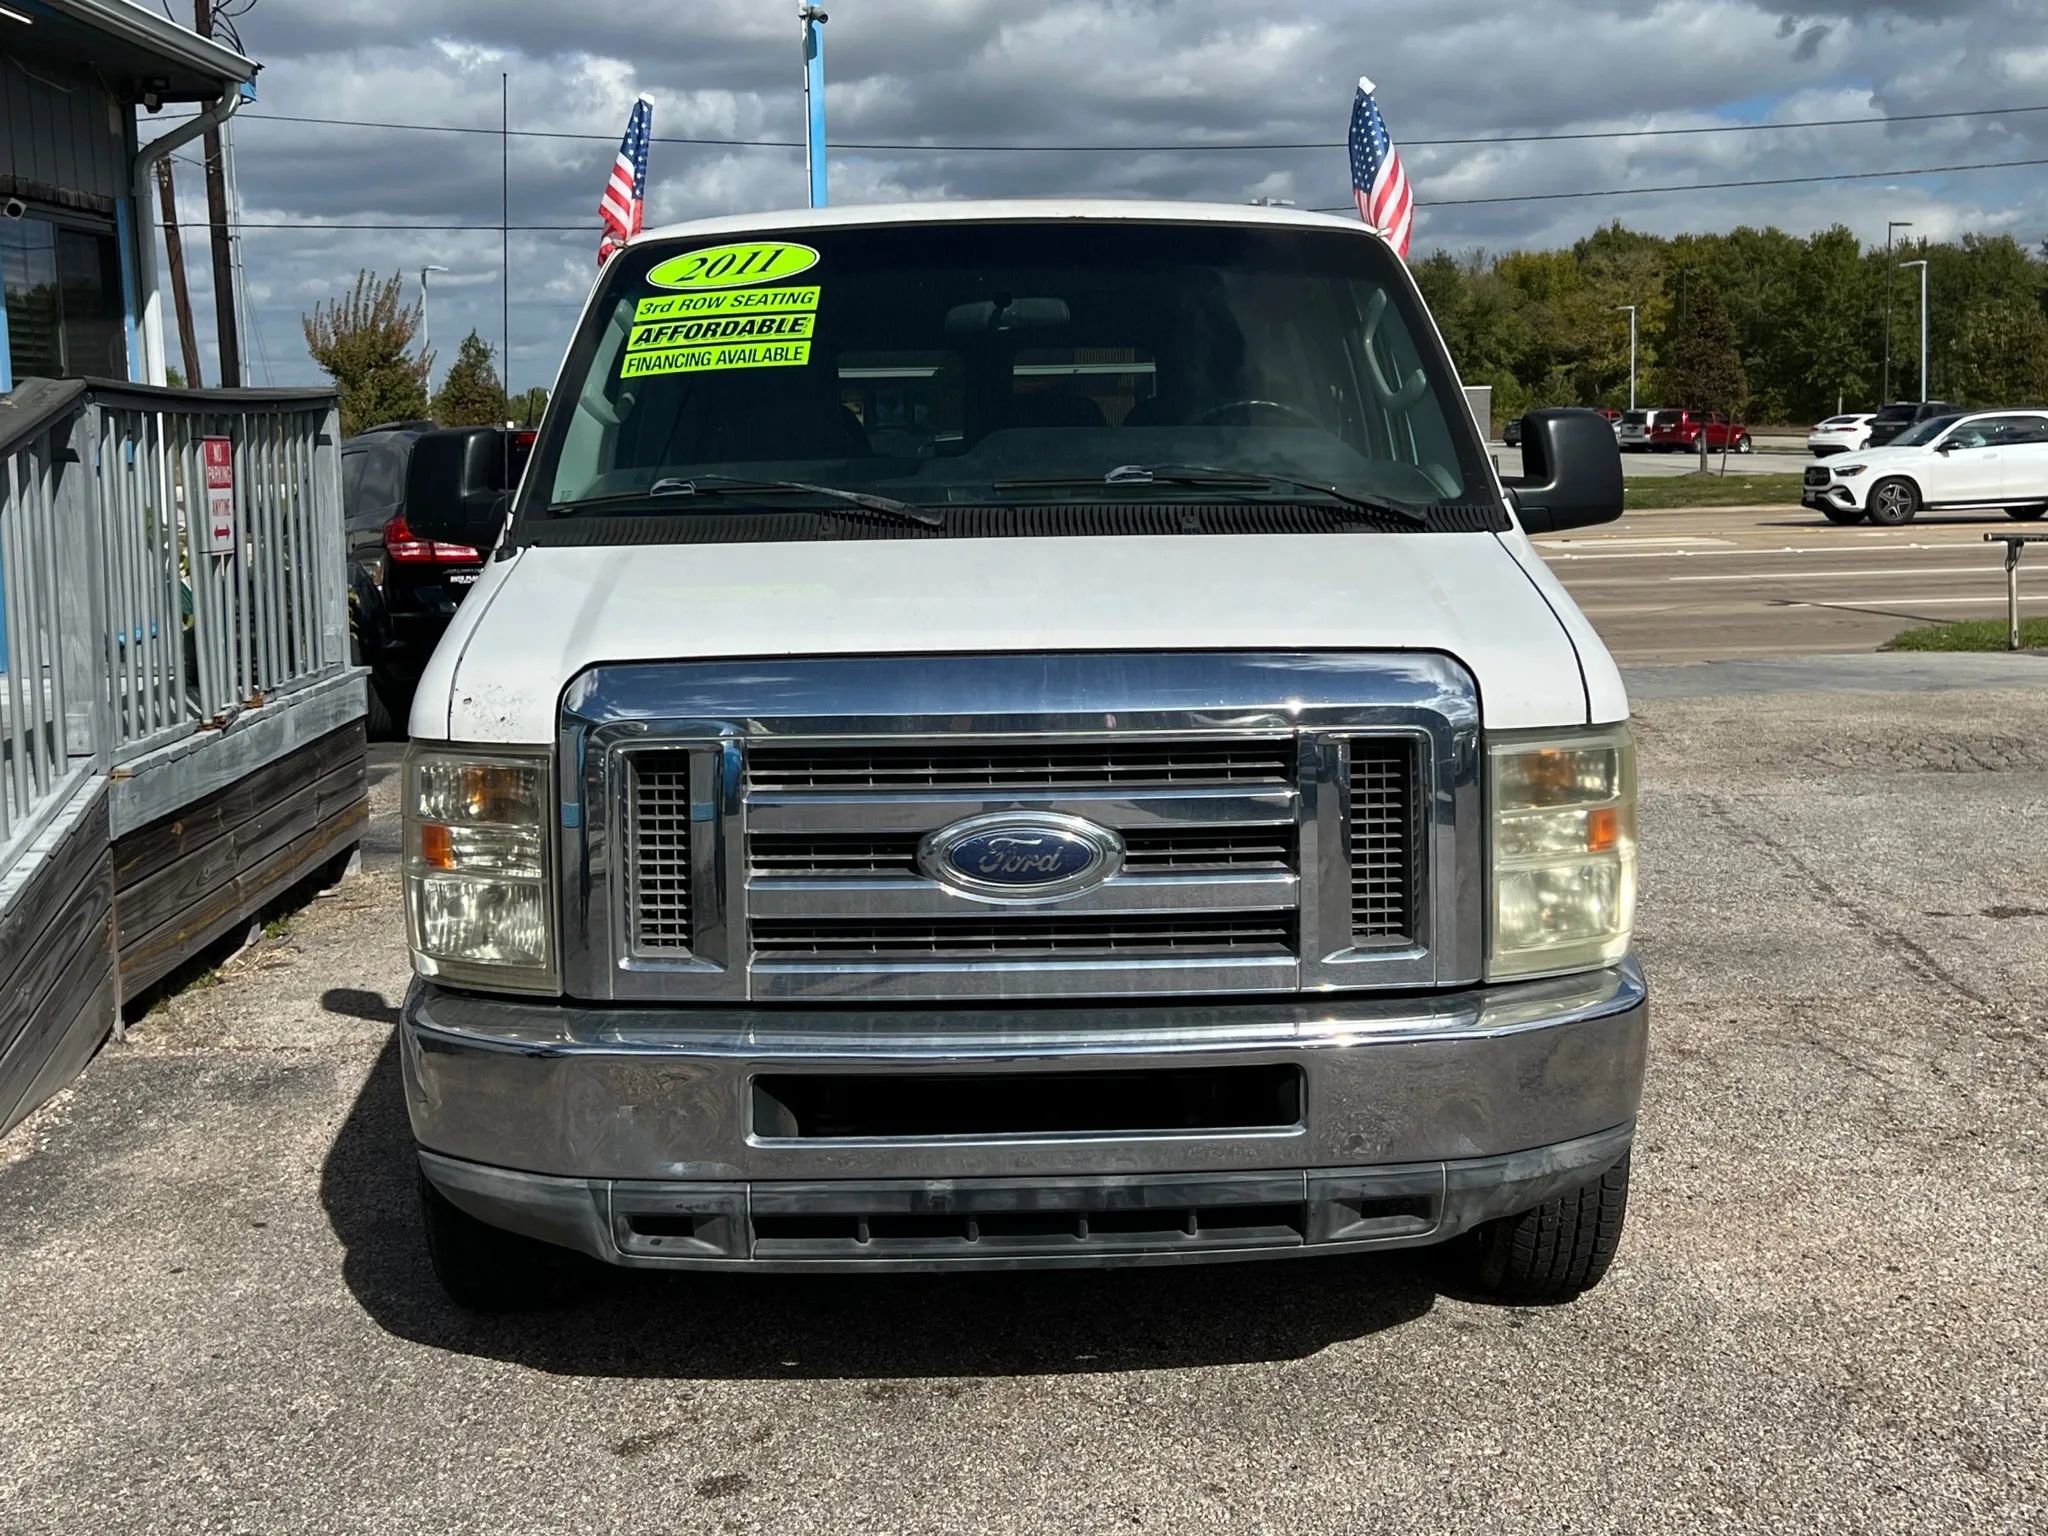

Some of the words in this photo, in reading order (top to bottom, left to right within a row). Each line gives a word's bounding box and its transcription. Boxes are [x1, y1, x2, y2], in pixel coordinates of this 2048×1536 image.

[674, 248, 786, 283] 2011
[640, 299, 674, 315] 3rd
[678, 296, 726, 311] ROW
[730, 291, 815, 308] SEATING
[632, 316, 810, 346] AFFORDABLE
[626, 351, 712, 373] FINANCING
[716, 346, 804, 365] AVAILABLE
[213, 443, 223, 462] NO
[979, 837, 1064, 873] Ford
